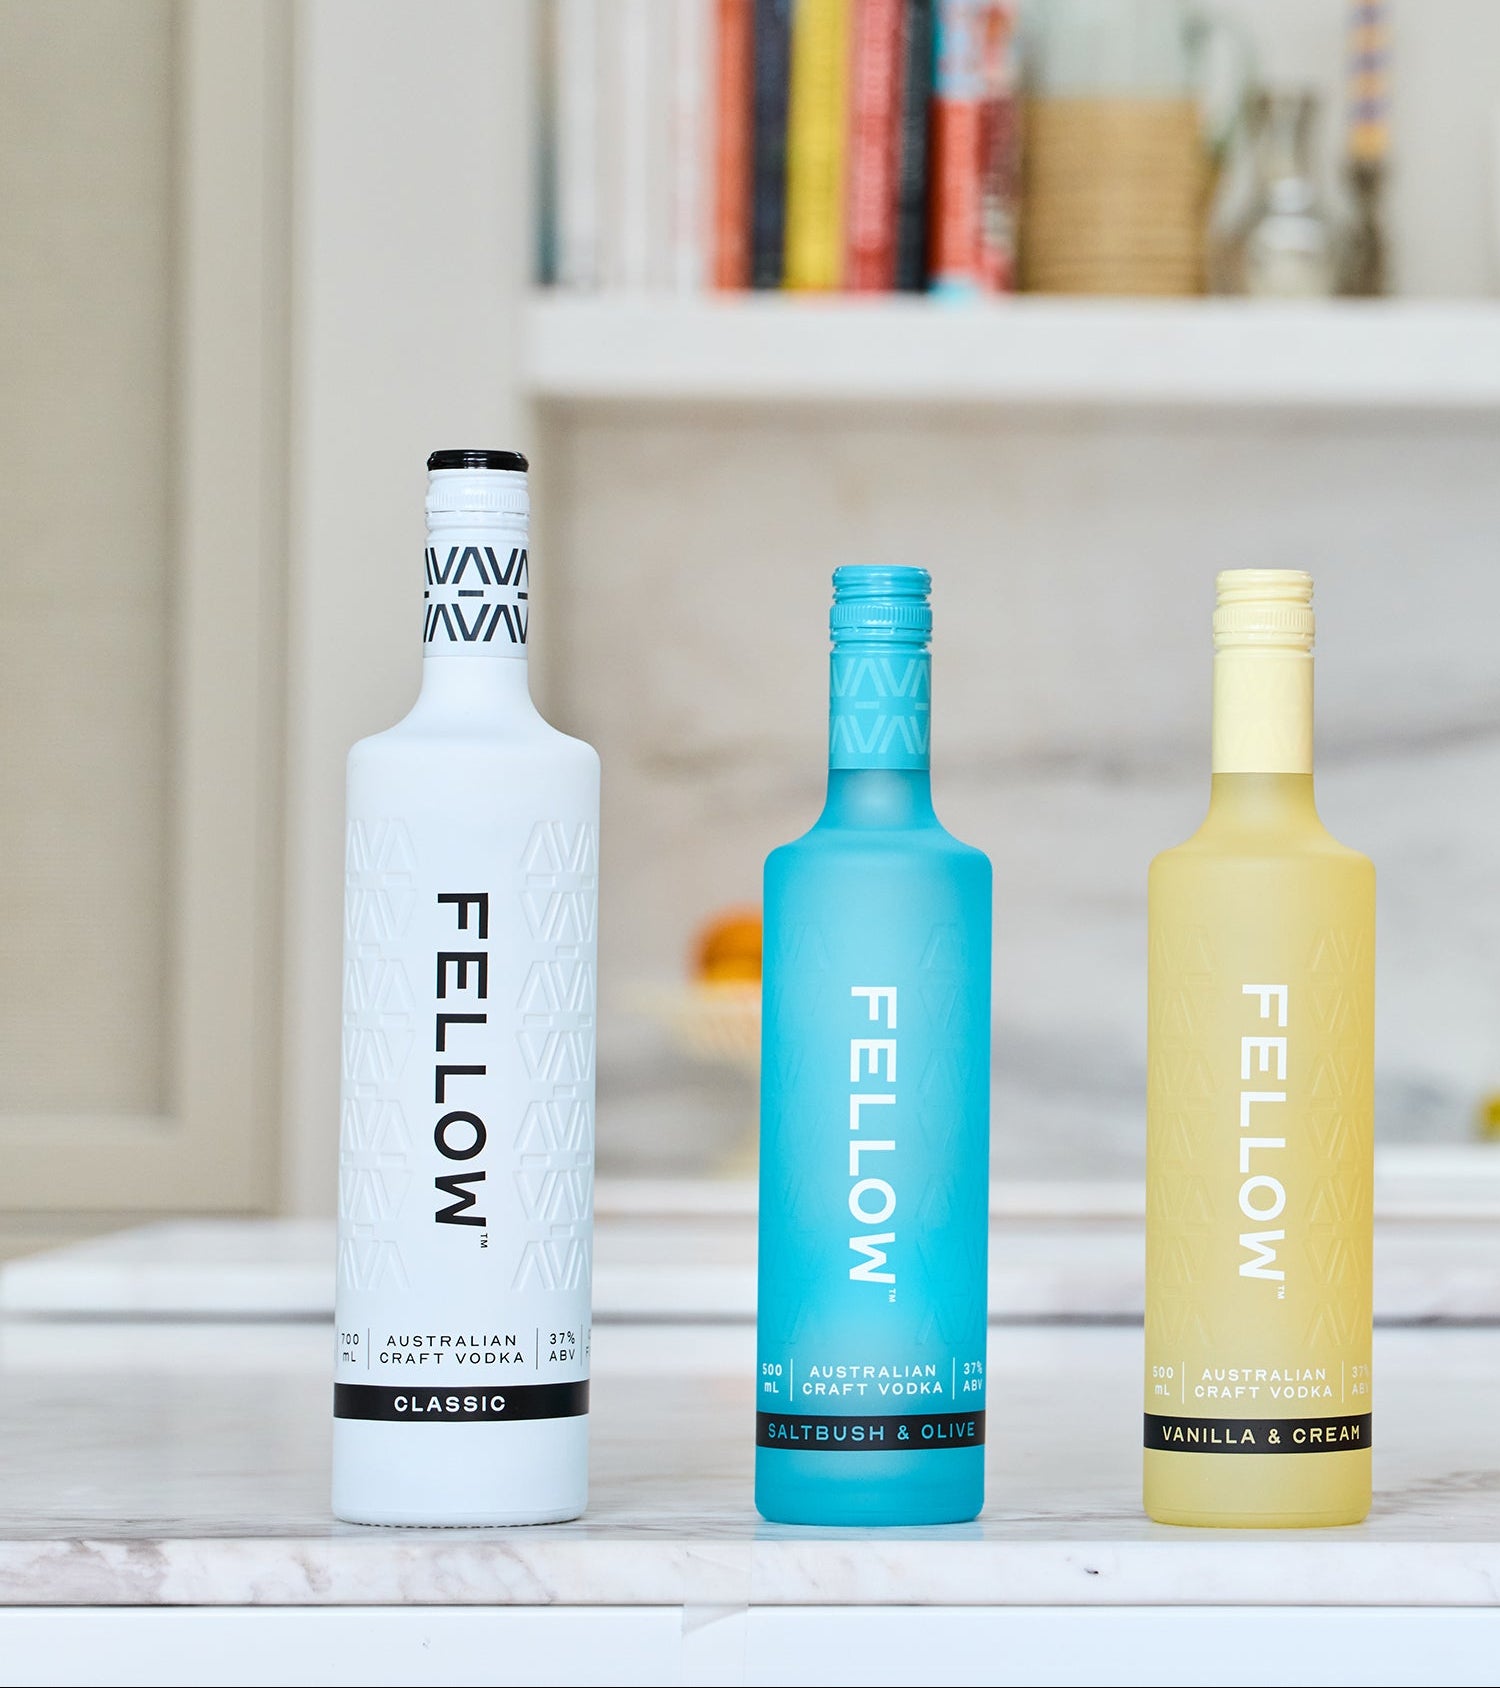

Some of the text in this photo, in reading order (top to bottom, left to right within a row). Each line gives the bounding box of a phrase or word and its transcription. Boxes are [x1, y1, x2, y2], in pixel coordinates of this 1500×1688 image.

[434, 892, 489, 1227] FELLOW
[848, 986, 897, 1284] FELLOW
[1238, 984, 1288, 1281] FELLOW
[341, 1332, 360, 1345] 700
[387, 1335, 517, 1347] AUSTRALIAN
[549, 1330, 576, 1345] 37%
[343, 1350, 357, 1362] mL
[379, 1352, 524, 1365] CRAFT VODKA
[549, 1348, 576, 1361] ABV
[762, 1363, 783, 1376] 500
[809, 1364, 937, 1379] AUSTRALIAN
[963, 1360, 983, 1375] 37%
[1152, 1365, 1174, 1379] 500
[1201, 1368, 1327, 1382] AUSTRALIAN
[764, 1381, 779, 1393] mL
[802, 1381, 943, 1396] CRAFT VODKA
[963, 1378, 983, 1392] ABV
[1154, 1383, 1170, 1396] mL
[1194, 1385, 1333, 1399] CRAFT VODKA
[394, 1395, 506, 1412] CLASSIC
[768, 1421, 976, 1441] SALTBUSH & OLIVE
[1162, 1424, 1360, 1444] VANILLA & CREAM
